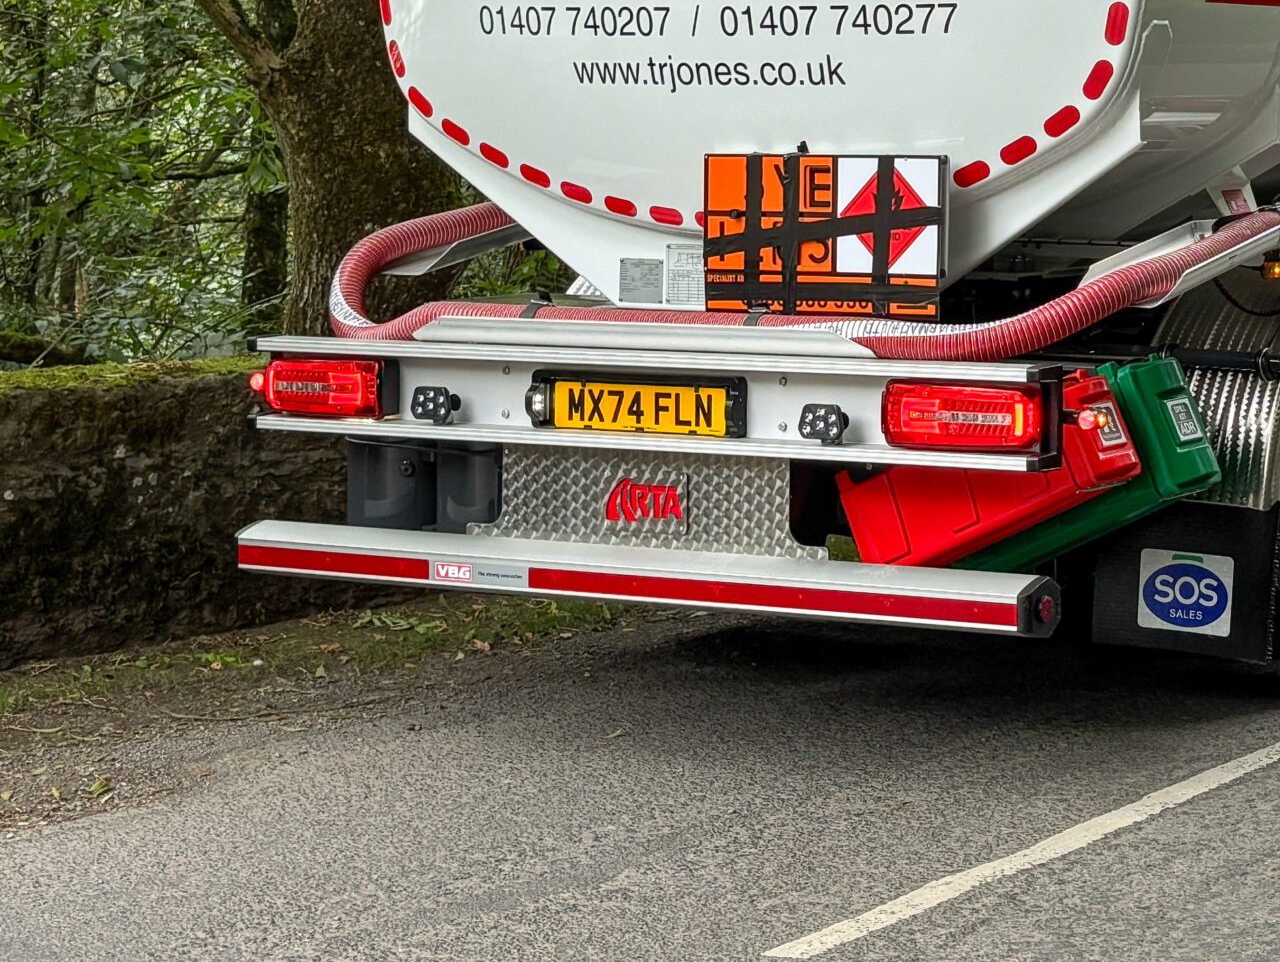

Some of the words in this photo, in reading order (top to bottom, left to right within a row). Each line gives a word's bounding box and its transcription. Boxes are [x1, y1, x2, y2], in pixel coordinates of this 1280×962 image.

[479, 5, 556, 36] 01407
[565, 6, 670, 37] 740207
[691, 4, 700, 37] /
[720, 5, 818, 37] 01407
[829, 2, 958, 36] 740277
[572, 54, 846, 94] www.trjones.co.uk
[567, 388, 645, 425] MX74
[654, 392, 713, 428] FLN
[1180, 421, 1197, 435] ADR
[437, 564, 471, 579] VBG
[1154, 574, 1219, 607] SOS
[1169, 608, 1203, 620] SALES
